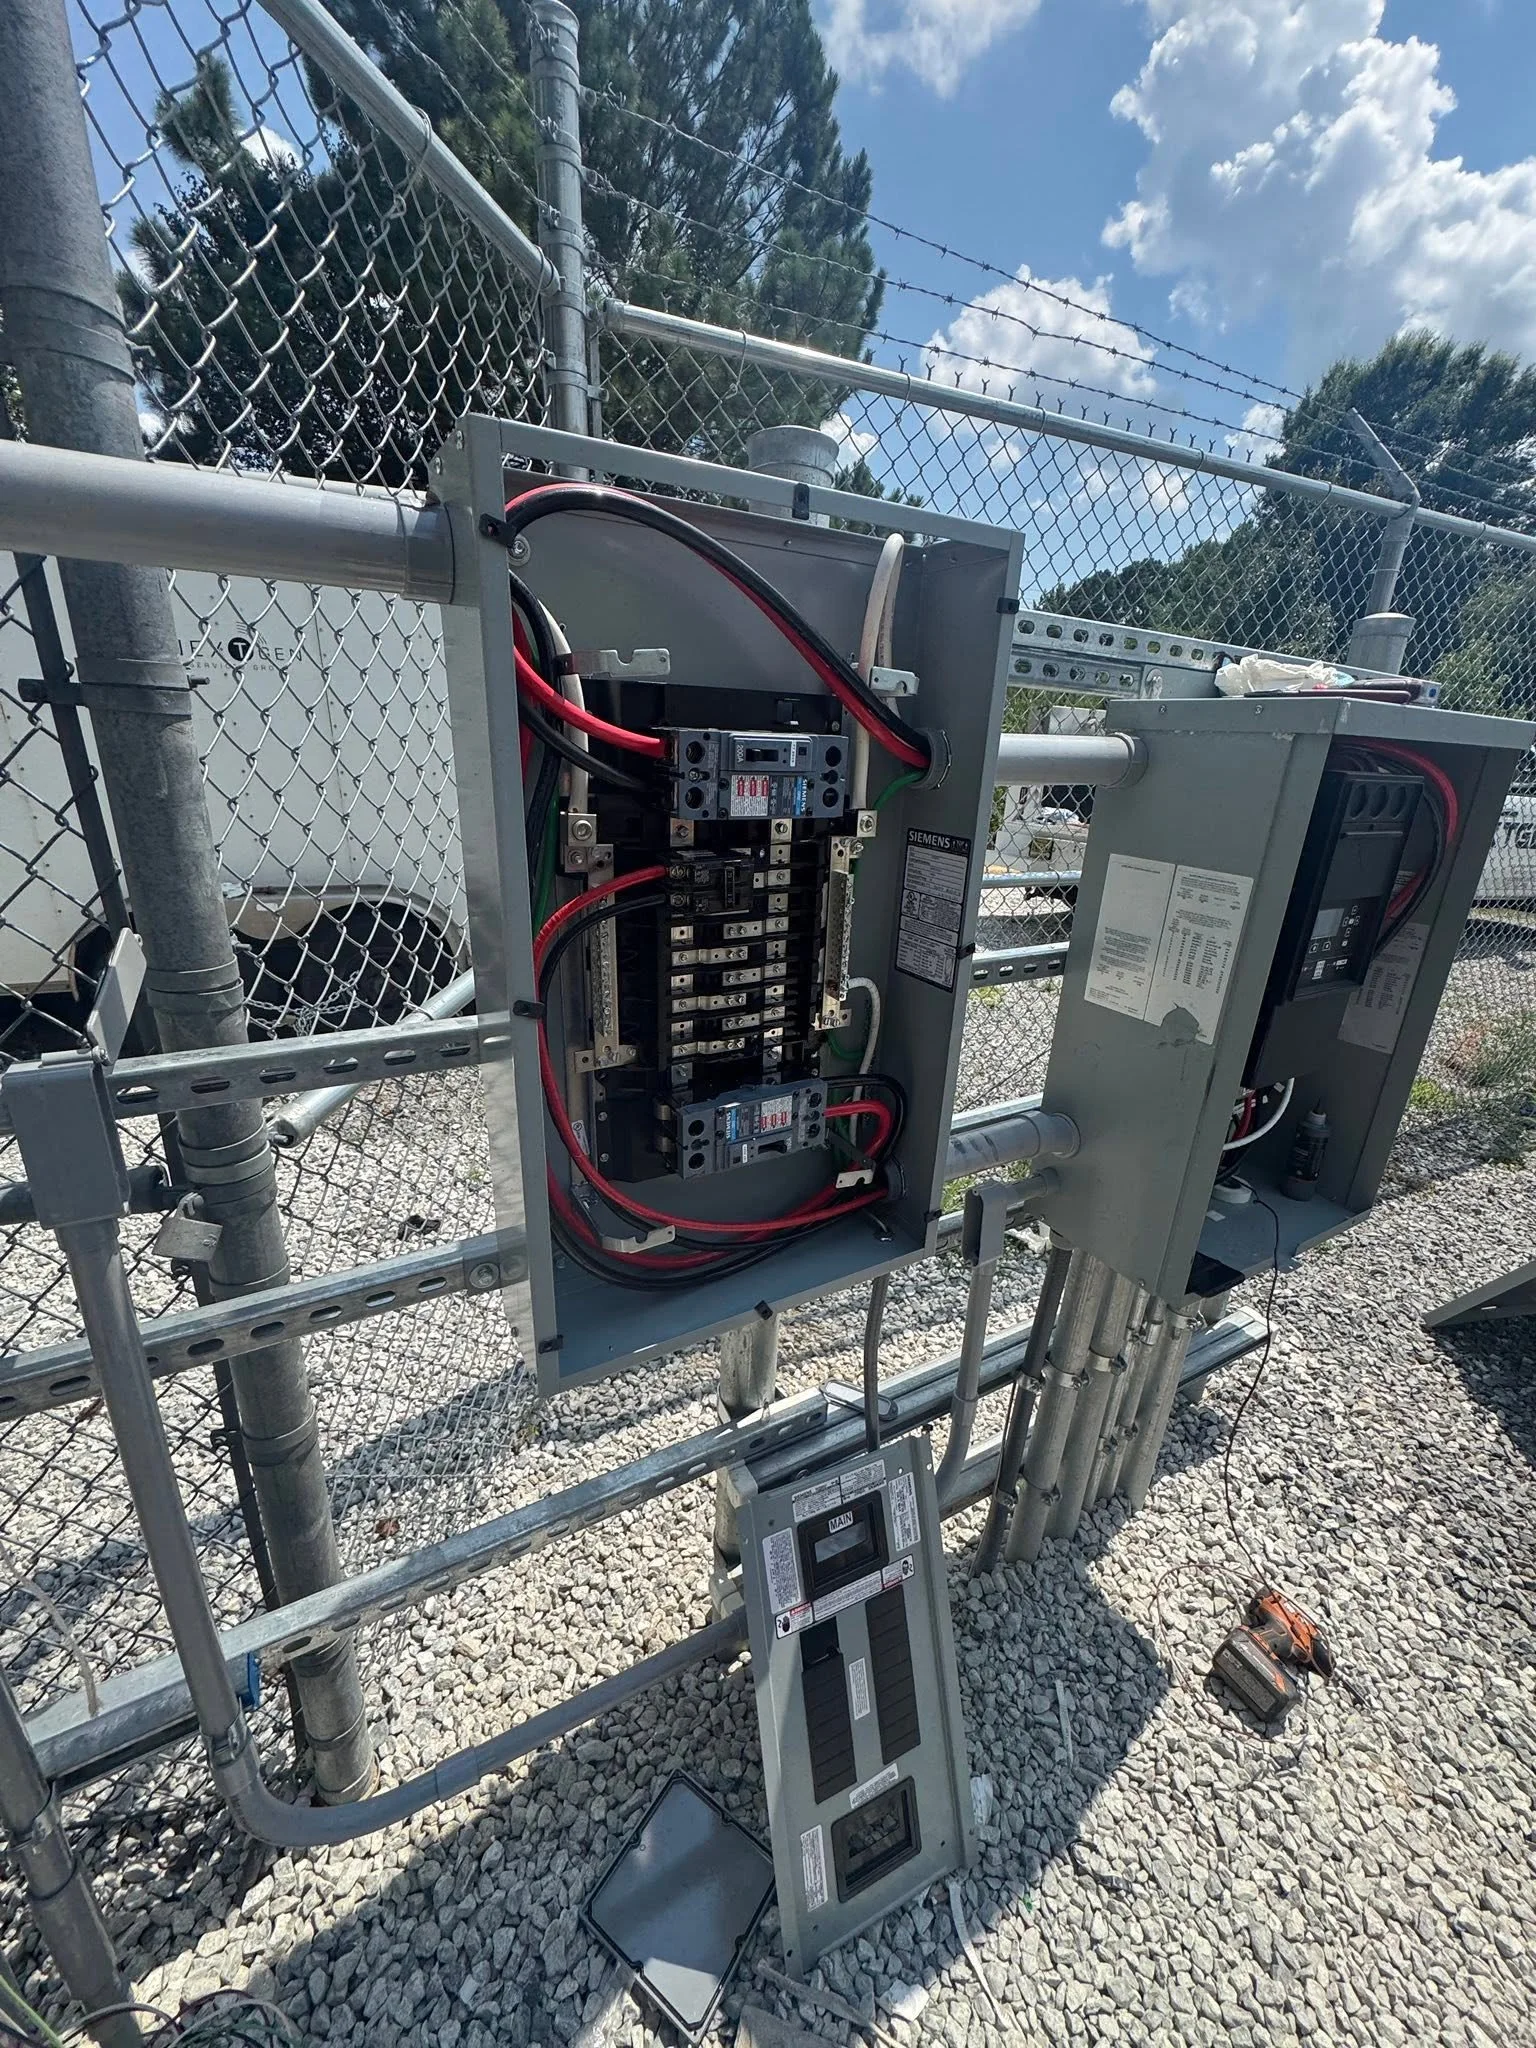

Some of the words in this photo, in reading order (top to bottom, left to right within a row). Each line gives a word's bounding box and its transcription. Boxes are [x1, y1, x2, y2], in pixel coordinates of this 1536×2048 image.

[736, 744, 744, 763] 200A
[909, 830, 951, 849] SIEMENS
[830, 1512, 853, 1531] MAIN
